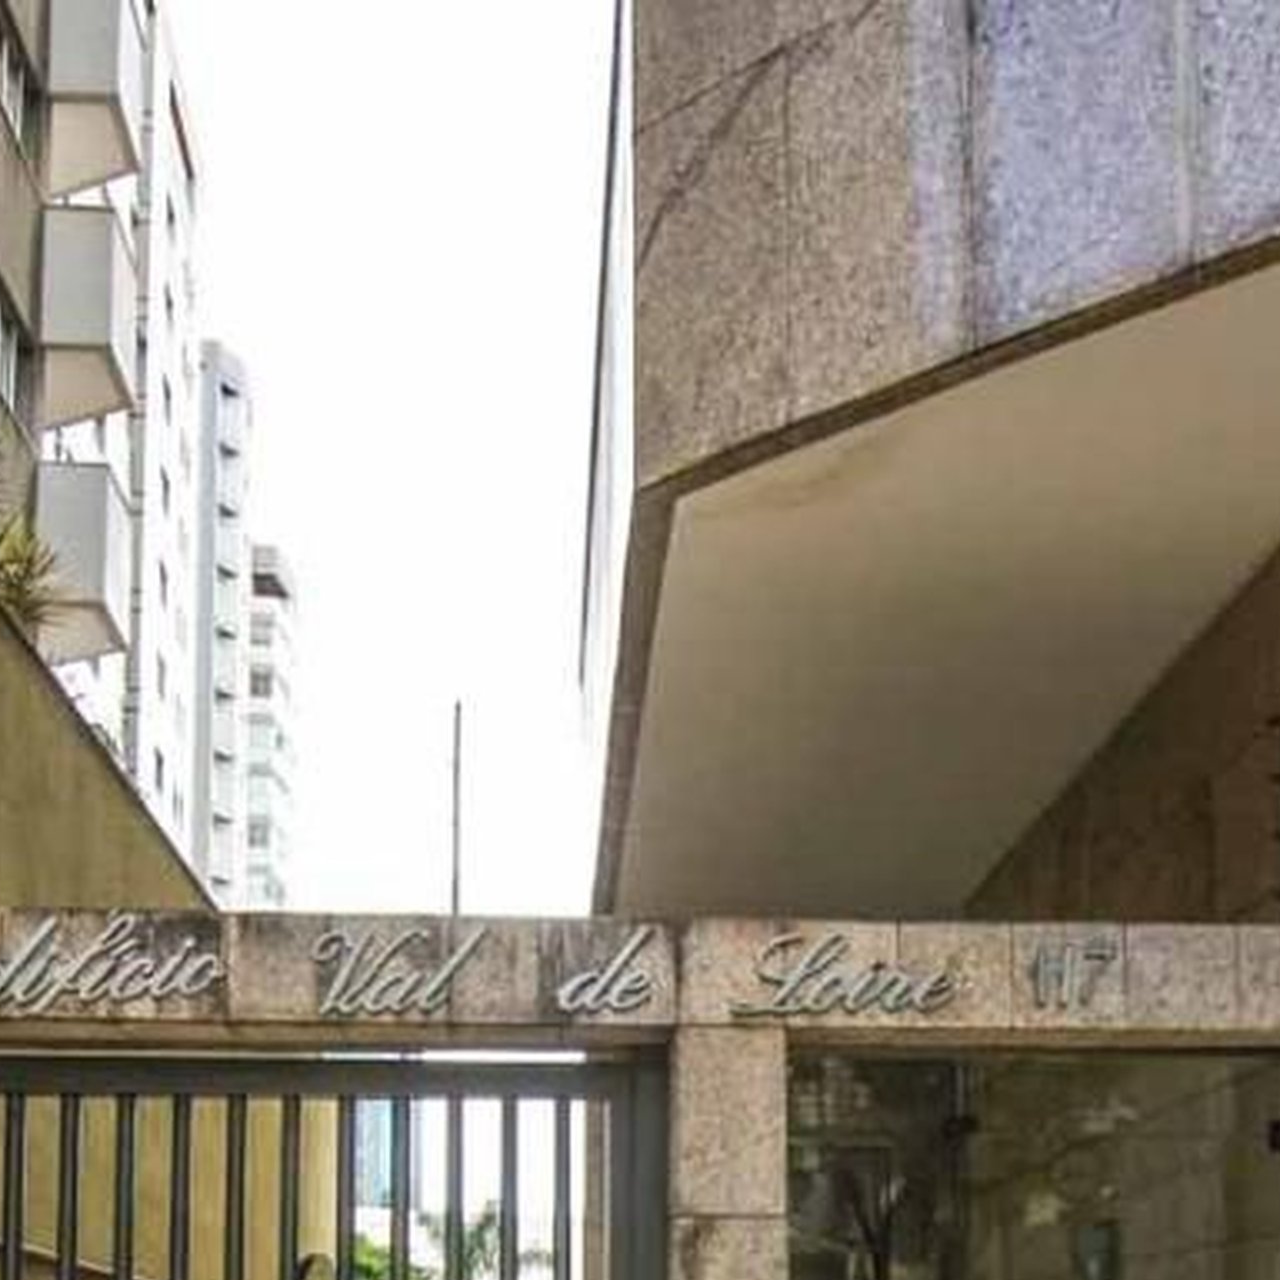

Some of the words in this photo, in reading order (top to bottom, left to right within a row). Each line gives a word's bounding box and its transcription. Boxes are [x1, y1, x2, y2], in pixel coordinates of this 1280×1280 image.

[312, 924, 489, 1015] Val
[557, 923, 657, 1014] de
[728, 932, 960, 1016] Loire
